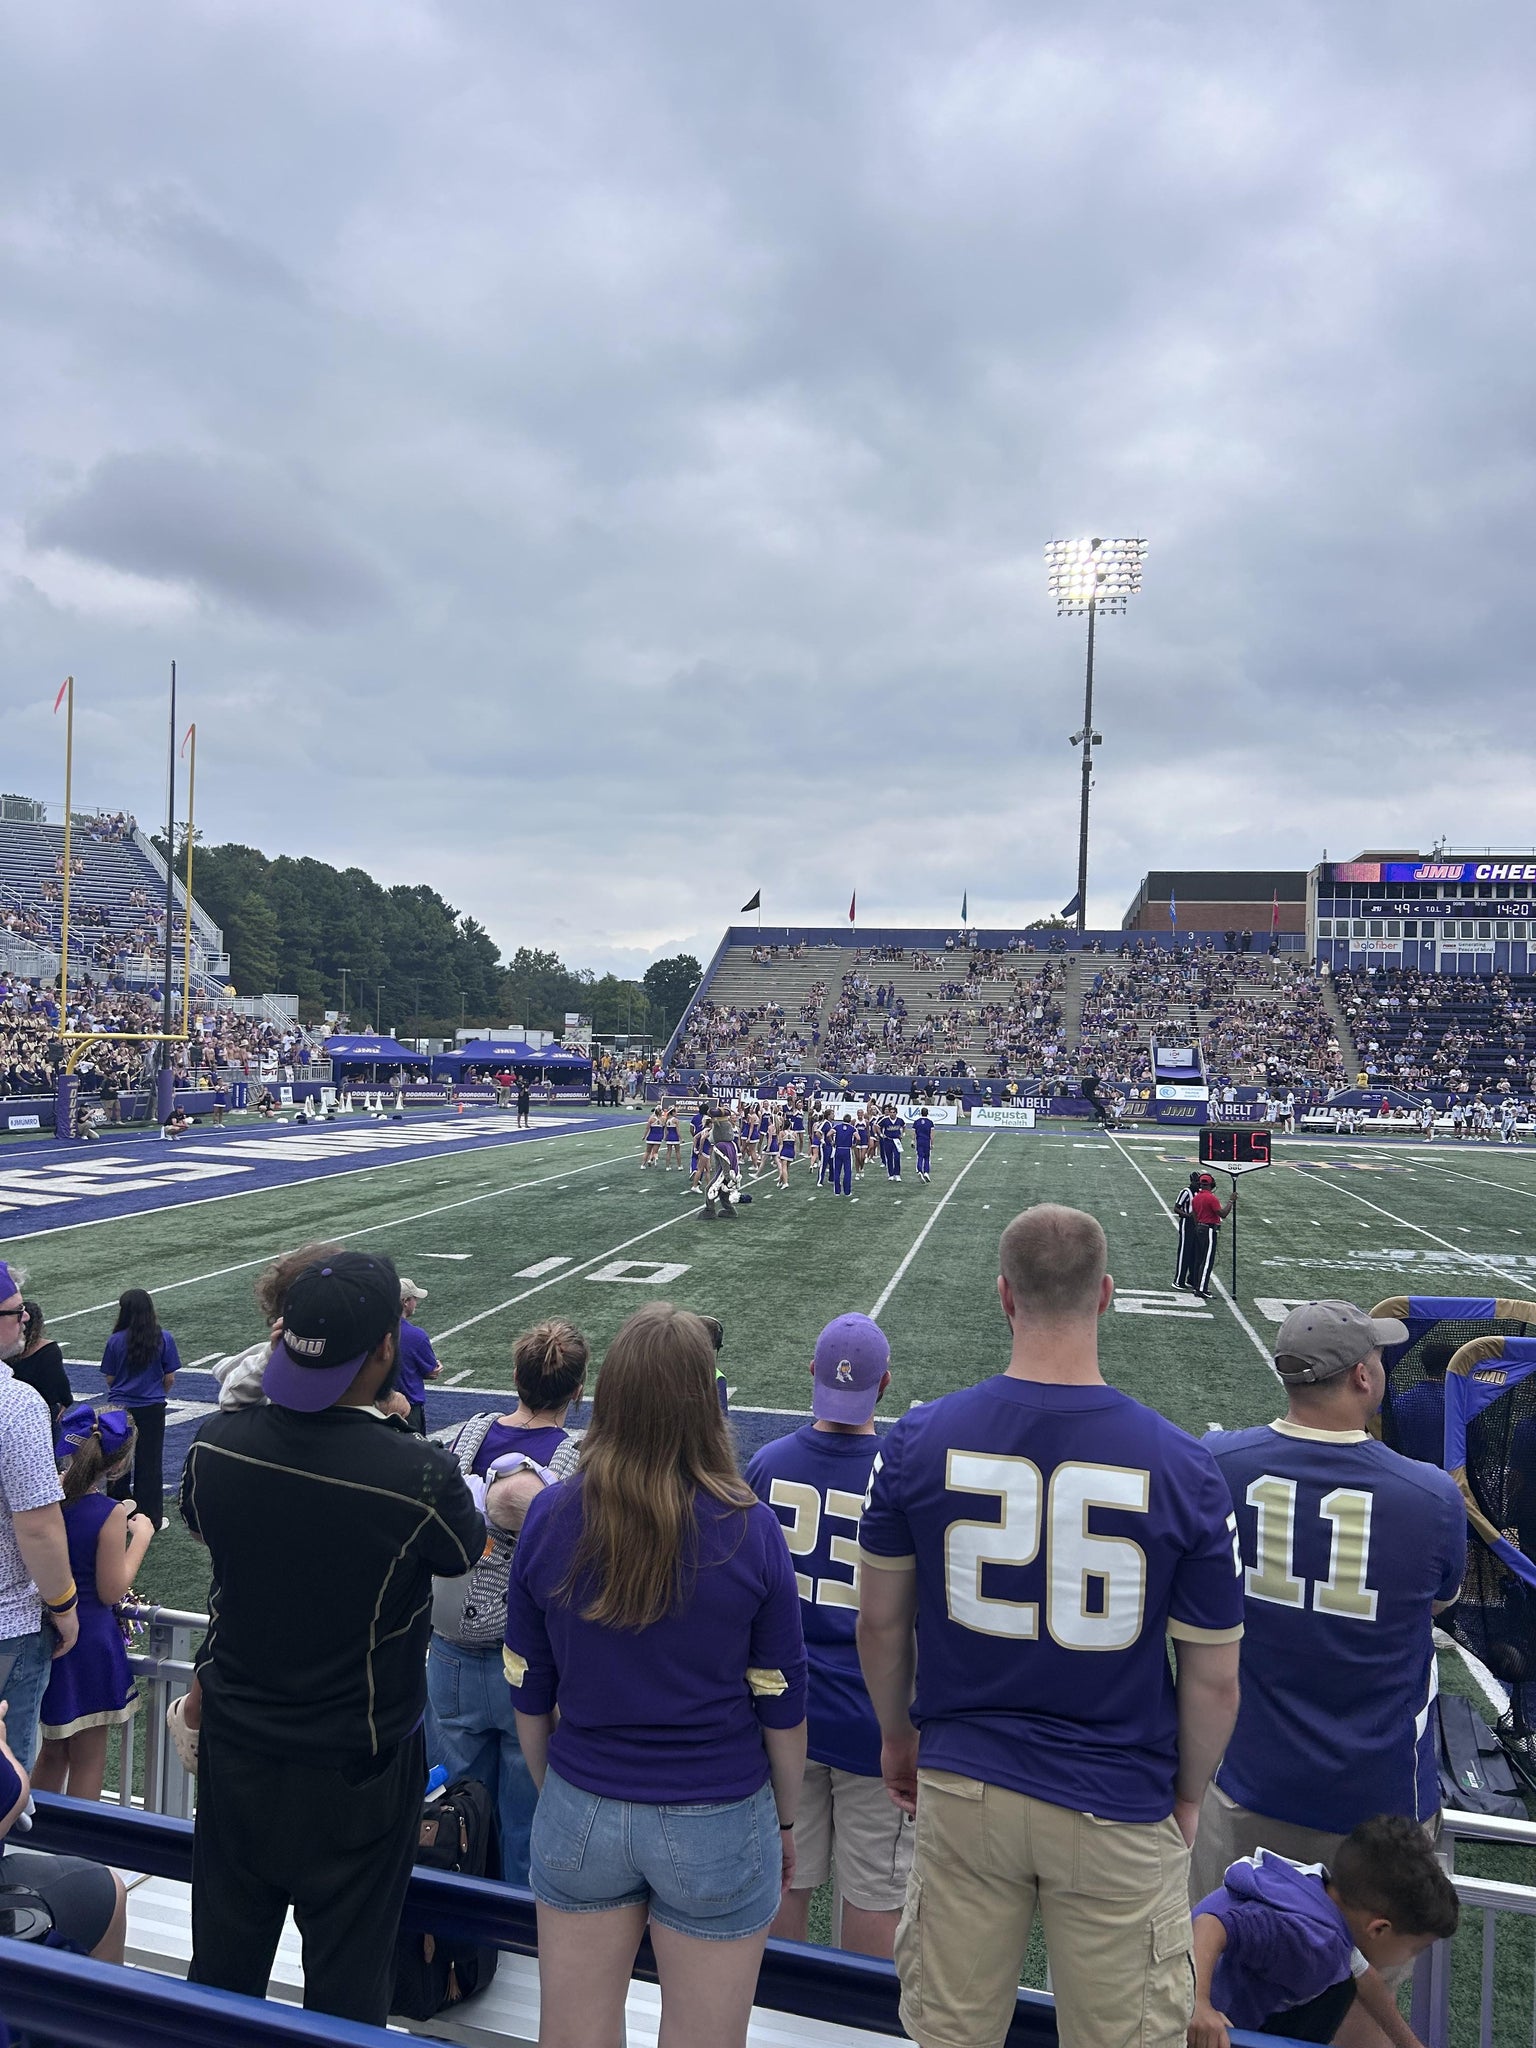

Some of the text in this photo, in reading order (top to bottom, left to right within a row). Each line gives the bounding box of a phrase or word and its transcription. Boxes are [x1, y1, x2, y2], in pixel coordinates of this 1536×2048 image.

[1415, 864, 1536, 880] JMU CHEE
[1394, 903, 1410, 915] 49
[1426, 905, 1442, 913] T.O.L.
[1445, 904, 1451, 914] 3
[1497, 903, 1529, 915] 14:20
[1188, 931, 1195, 940] 3
[1424, 942, 1431, 951] 4
[712, 1087, 734, 1098] SUN
[1026, 1097, 1052, 1109] BELT
[69, 1088, 78, 1138] DUKES
[977, 1108, 1028, 1121] Augusta
[1160, 1105, 1198, 1117] JMU
[1225, 1104, 1253, 1116] BELT
[1001, 1119, 1028, 1127] Health
[1208, 1132, 1268, 1163] 1:15
[1473, 1370, 1506, 1385] JMU
[769, 1478, 864, 1611] 23
[945, 1448, 1150, 1652] 26
[1244, 1474, 1379, 1622] 11
